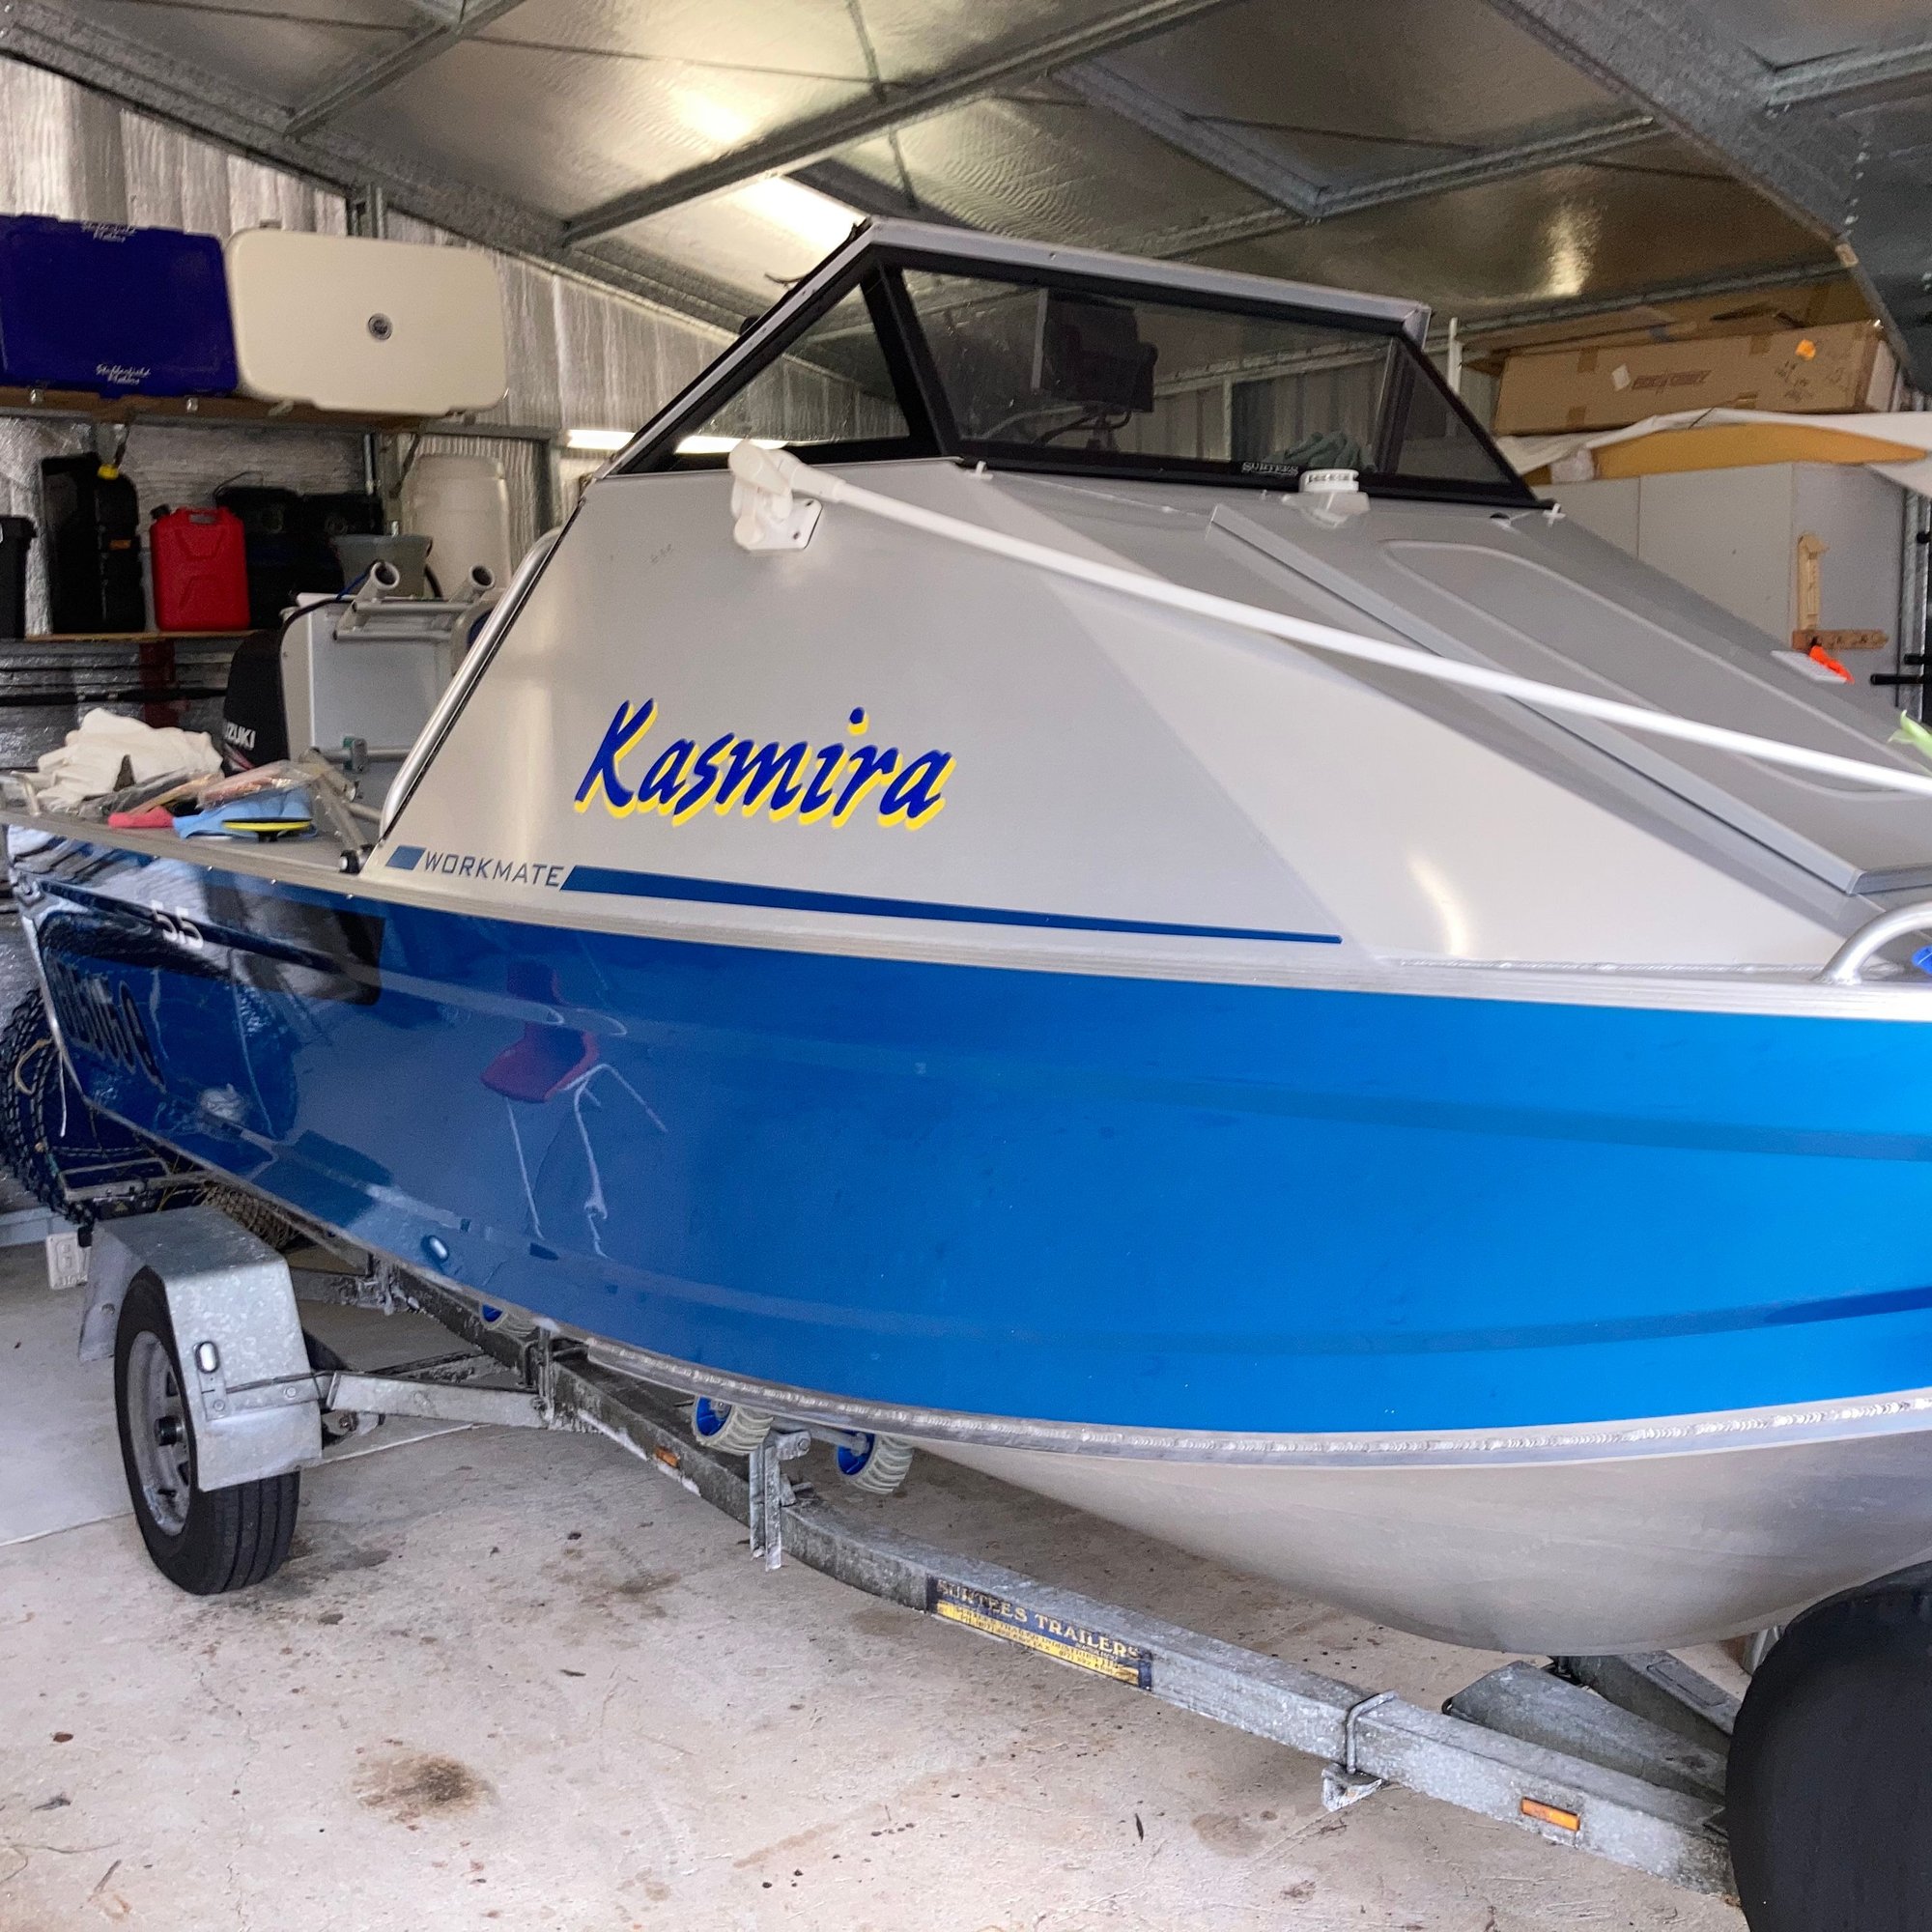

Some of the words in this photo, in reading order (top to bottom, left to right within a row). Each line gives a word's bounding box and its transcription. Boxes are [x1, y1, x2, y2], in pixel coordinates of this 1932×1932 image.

[223, 721, 256, 750] ZUKI
[575, 697, 956, 829] Kasmira
[425, 850, 564, 888] WORKMATE
[151, 899, 204, 950] 5.5
[1035, 1613, 1140, 1659] TRAILERS
